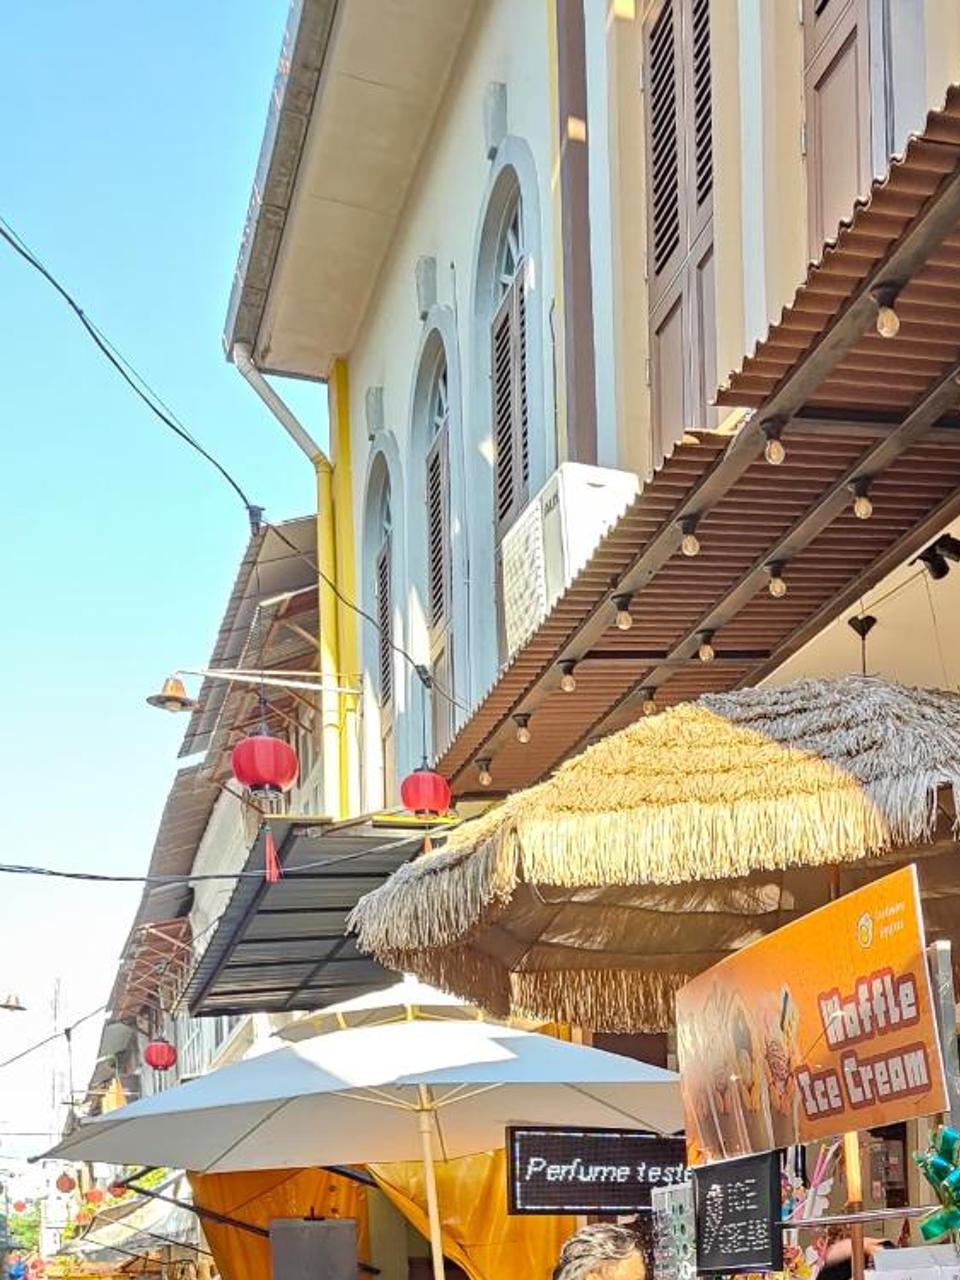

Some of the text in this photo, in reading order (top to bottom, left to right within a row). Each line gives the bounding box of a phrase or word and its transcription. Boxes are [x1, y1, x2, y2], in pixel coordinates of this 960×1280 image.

[819, 970, 918, 1046] Waffle
[799, 1047, 930, 1117] Ice Cream
[525, 1157, 695, 1182] Perfume teste
